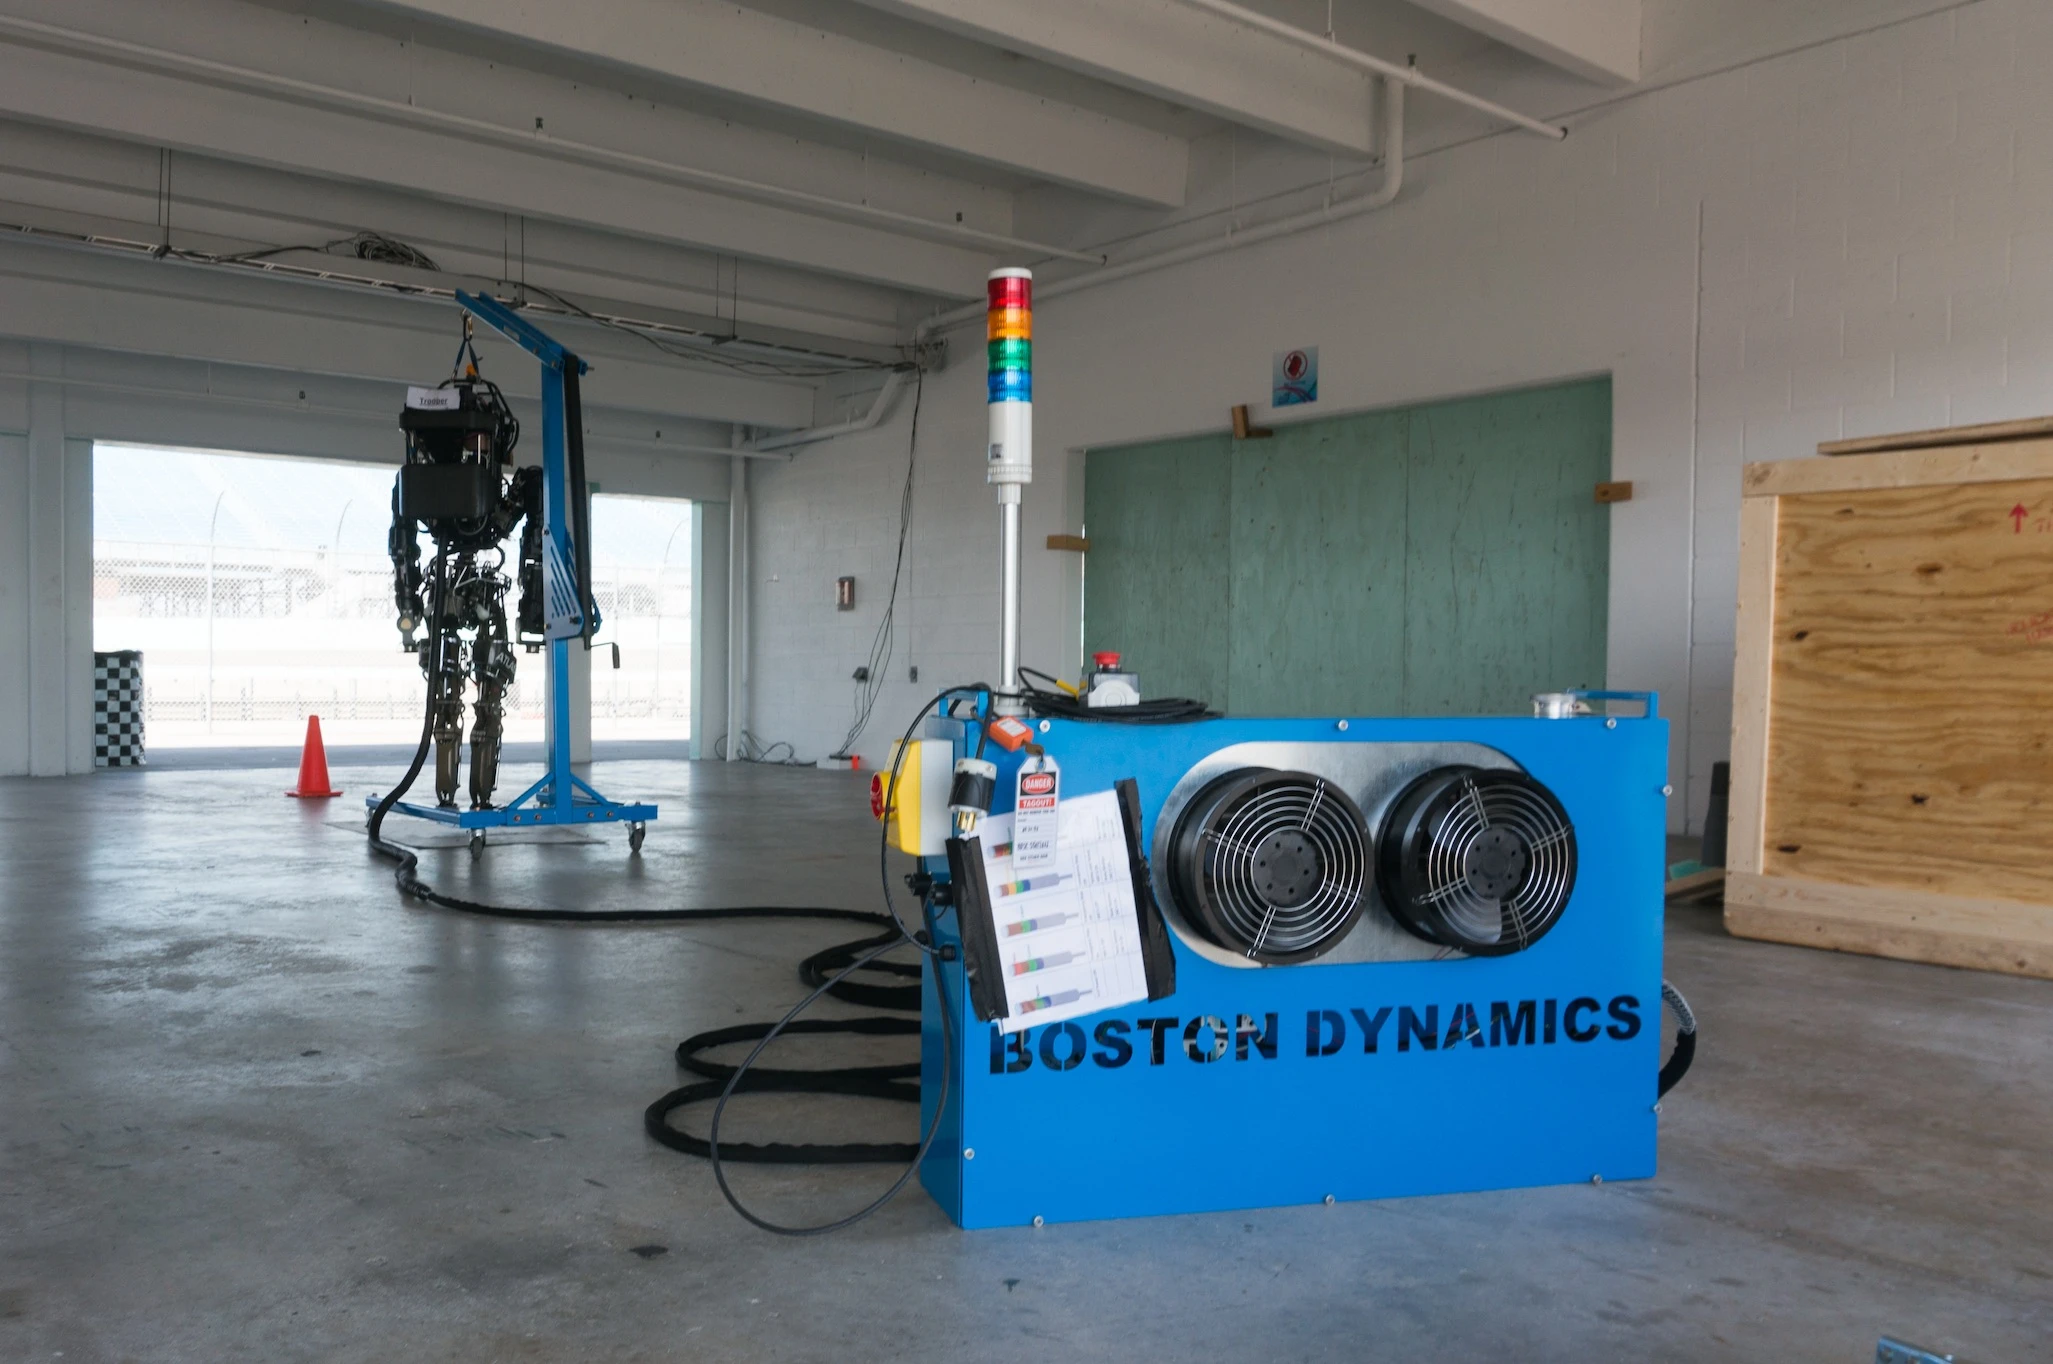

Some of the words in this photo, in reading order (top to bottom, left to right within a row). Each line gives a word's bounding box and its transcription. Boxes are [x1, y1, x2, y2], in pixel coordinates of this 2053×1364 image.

[420, 397, 448, 406] Trooper
[1025, 777, 1052, 789] DANGER
[1024, 797, 1053, 809] TAGOUT!
[990, 1012, 1278, 1074] BOSTON
[1305, 995, 1642, 1057] DYNAMICS
